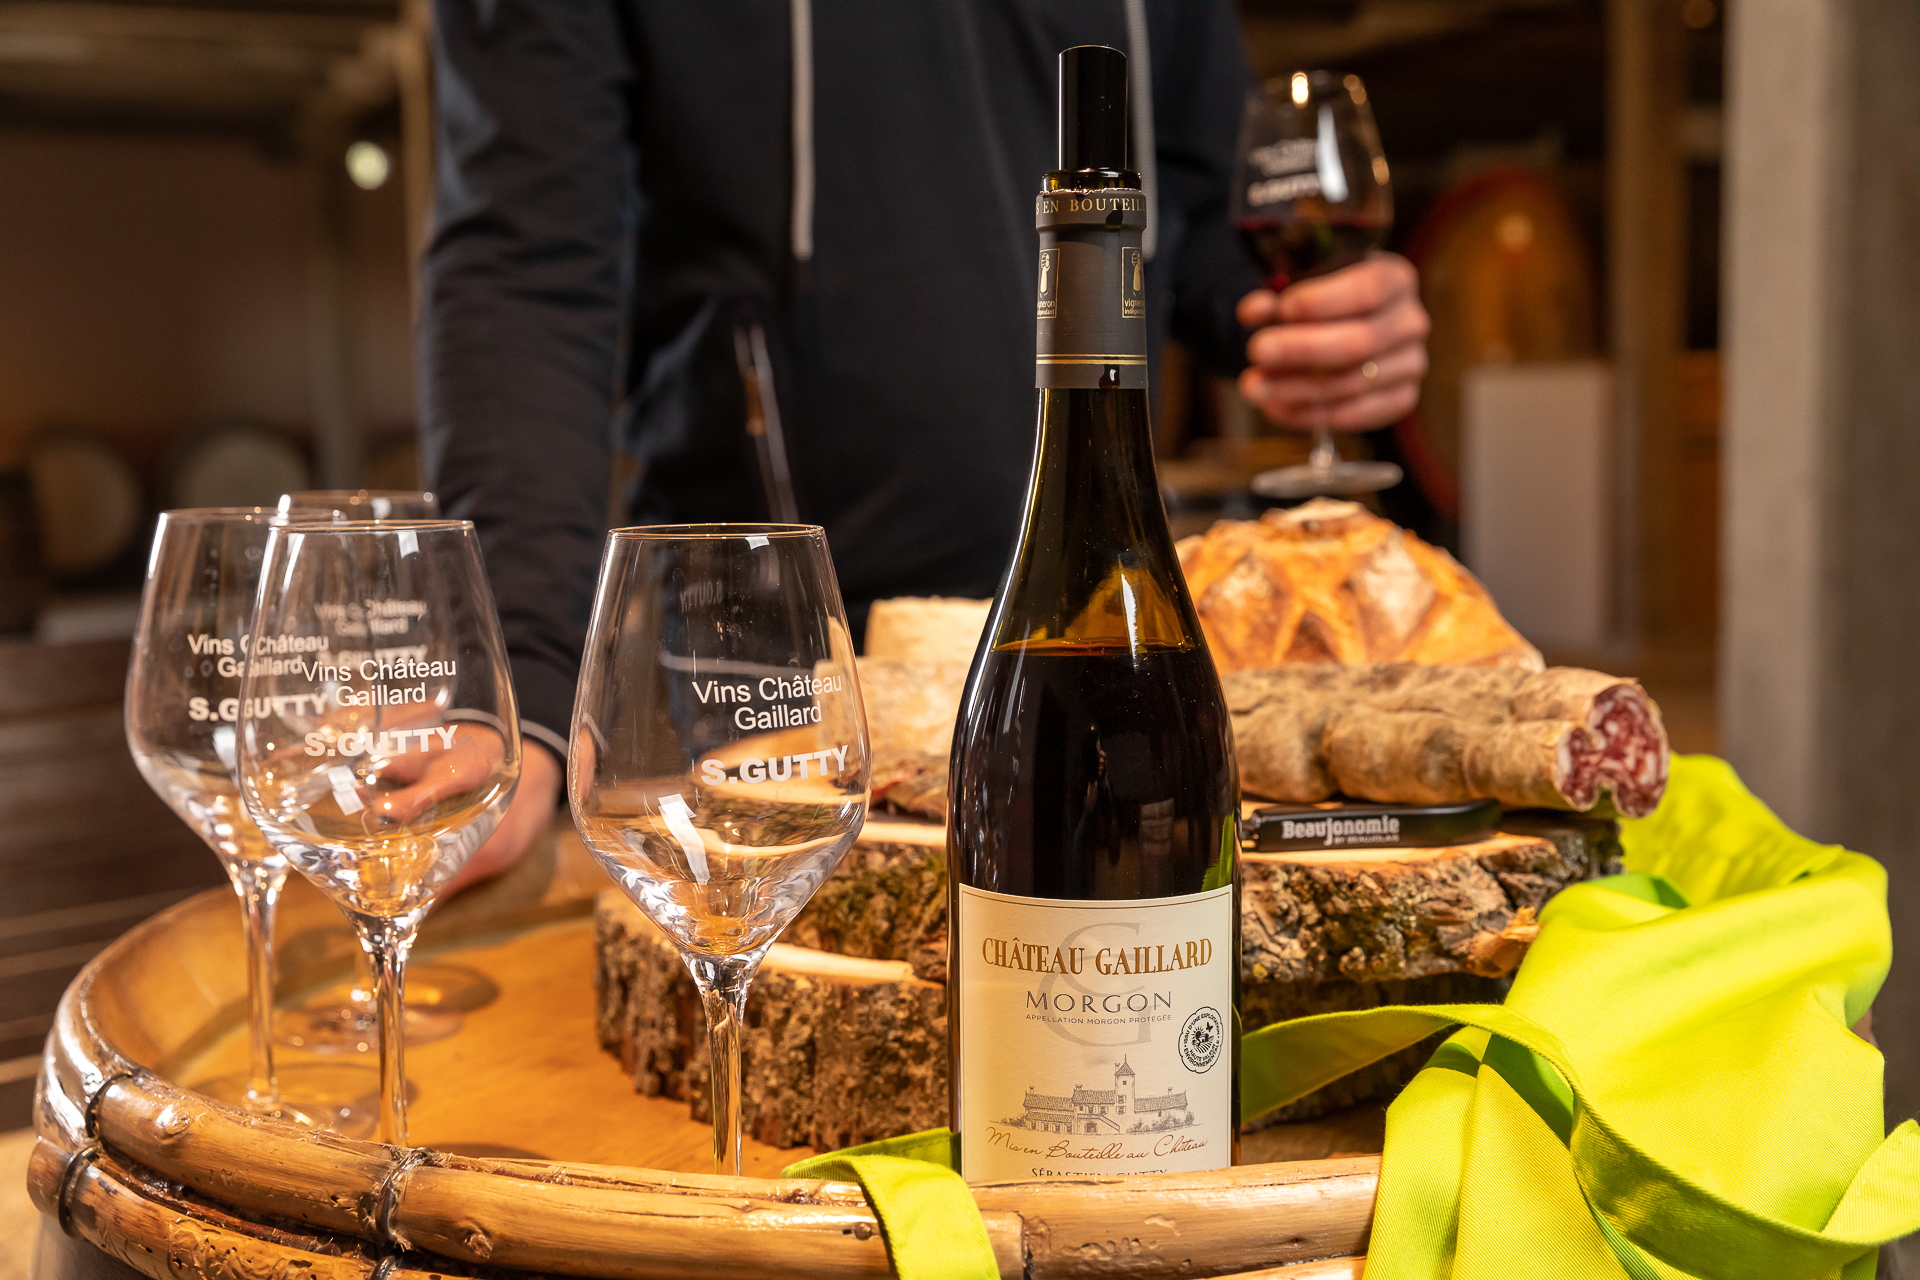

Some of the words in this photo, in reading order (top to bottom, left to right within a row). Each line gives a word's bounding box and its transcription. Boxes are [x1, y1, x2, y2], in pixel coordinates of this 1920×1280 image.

[1043, 200, 1059, 213] EN
[187, 634, 235, 655] Vins
[301, 662, 351, 682] Vins
[359, 657, 457, 681] Château
[335, 682, 426, 706] Gaillard
[692, 681, 751, 703] Vins
[759, 675, 842, 701] Château
[735, 700, 822, 730] Gaillard
[304, 725, 458, 757] S.GUTTY
[701, 745, 848, 785] S.GUTTY
[1282, 815, 1400, 846] Beaujonomie
[982, 937, 1085, 975] CHÂTEAU
[1095, 938, 1213, 976] GAILLARD
[1026, 991, 1172, 1013] MORGON
[1026, 1014, 1084, 1024] APPELLATION
[985, 1127, 1023, 1151] Mis
[1023, 1146, 1043, 1155] en
[1045, 1139, 1125, 1160] Bouteille
[1127, 1151, 1149, 1160] au
[1154, 1134, 1208, 1157] Château
